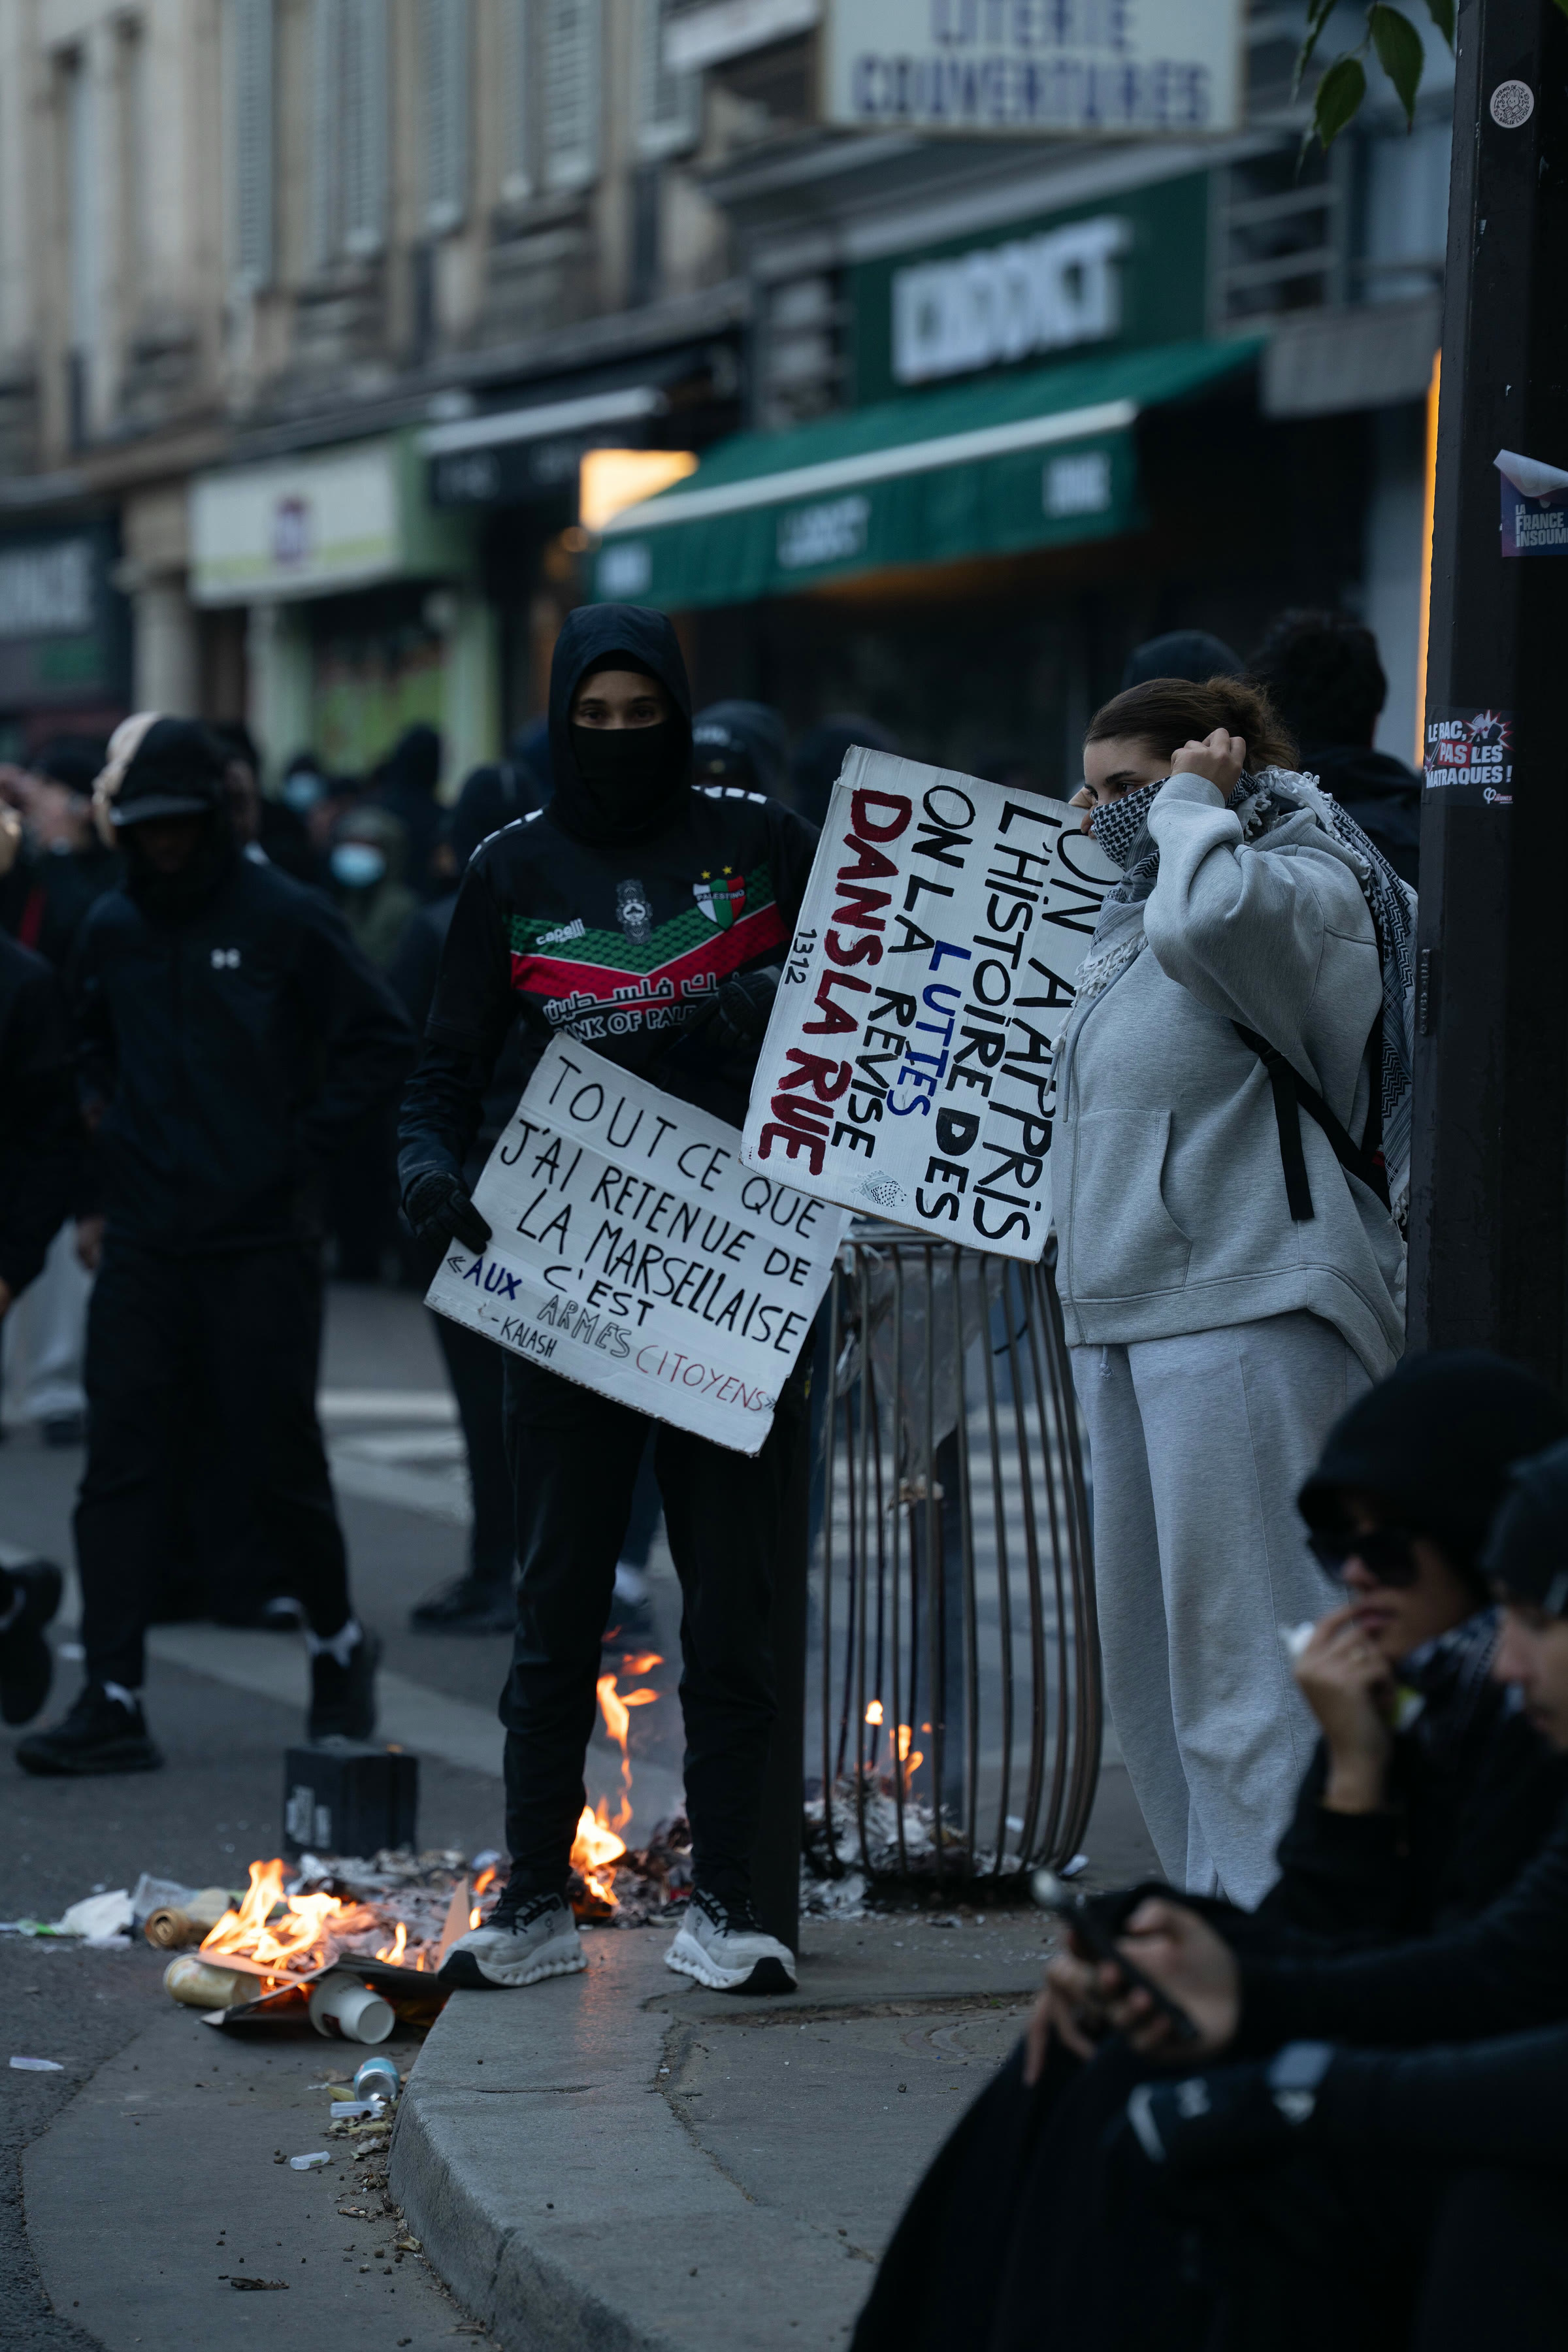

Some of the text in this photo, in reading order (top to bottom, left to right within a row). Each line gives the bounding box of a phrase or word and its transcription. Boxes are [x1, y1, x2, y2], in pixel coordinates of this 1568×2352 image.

[1495, 86, 1511, 99] PERMIS
[1516, 504, 1526, 515] LA
[1516, 512, 1565, 535] FRANCE
[1428, 720, 1467, 743] LE BAC,
[1439, 742, 1503, 764] PAS LES
[1426, 765, 1503, 789] MATRAQUES
[911, 785, 976, 869] ON
[696, 889, 745, 902] PALESTINO
[1042, 828, 1120, 935] ON
[536, 917, 586, 945] capelli
[887, 874, 955, 953] LA
[758, 788, 912, 1176] DANS LA RUE
[785, 929, 817, 984] 1312
[1013, 958, 1077, 1007] A
[543, 977, 675, 1025] فلسطين
[607, 1010, 642, 1035] OF
[887, 940, 972, 1117] LUTTES
[549, 1056, 825, 1238] TOUT CE QUE
[915, 1107, 981, 1221] DES
[501, 1119, 811, 1286] J'AI RETENUE DE
[517, 1188, 808, 1354] LA MARSELLAISE
[544, 1266, 655, 1326] C'EST
[537, 1294, 632, 1358] ARMES
